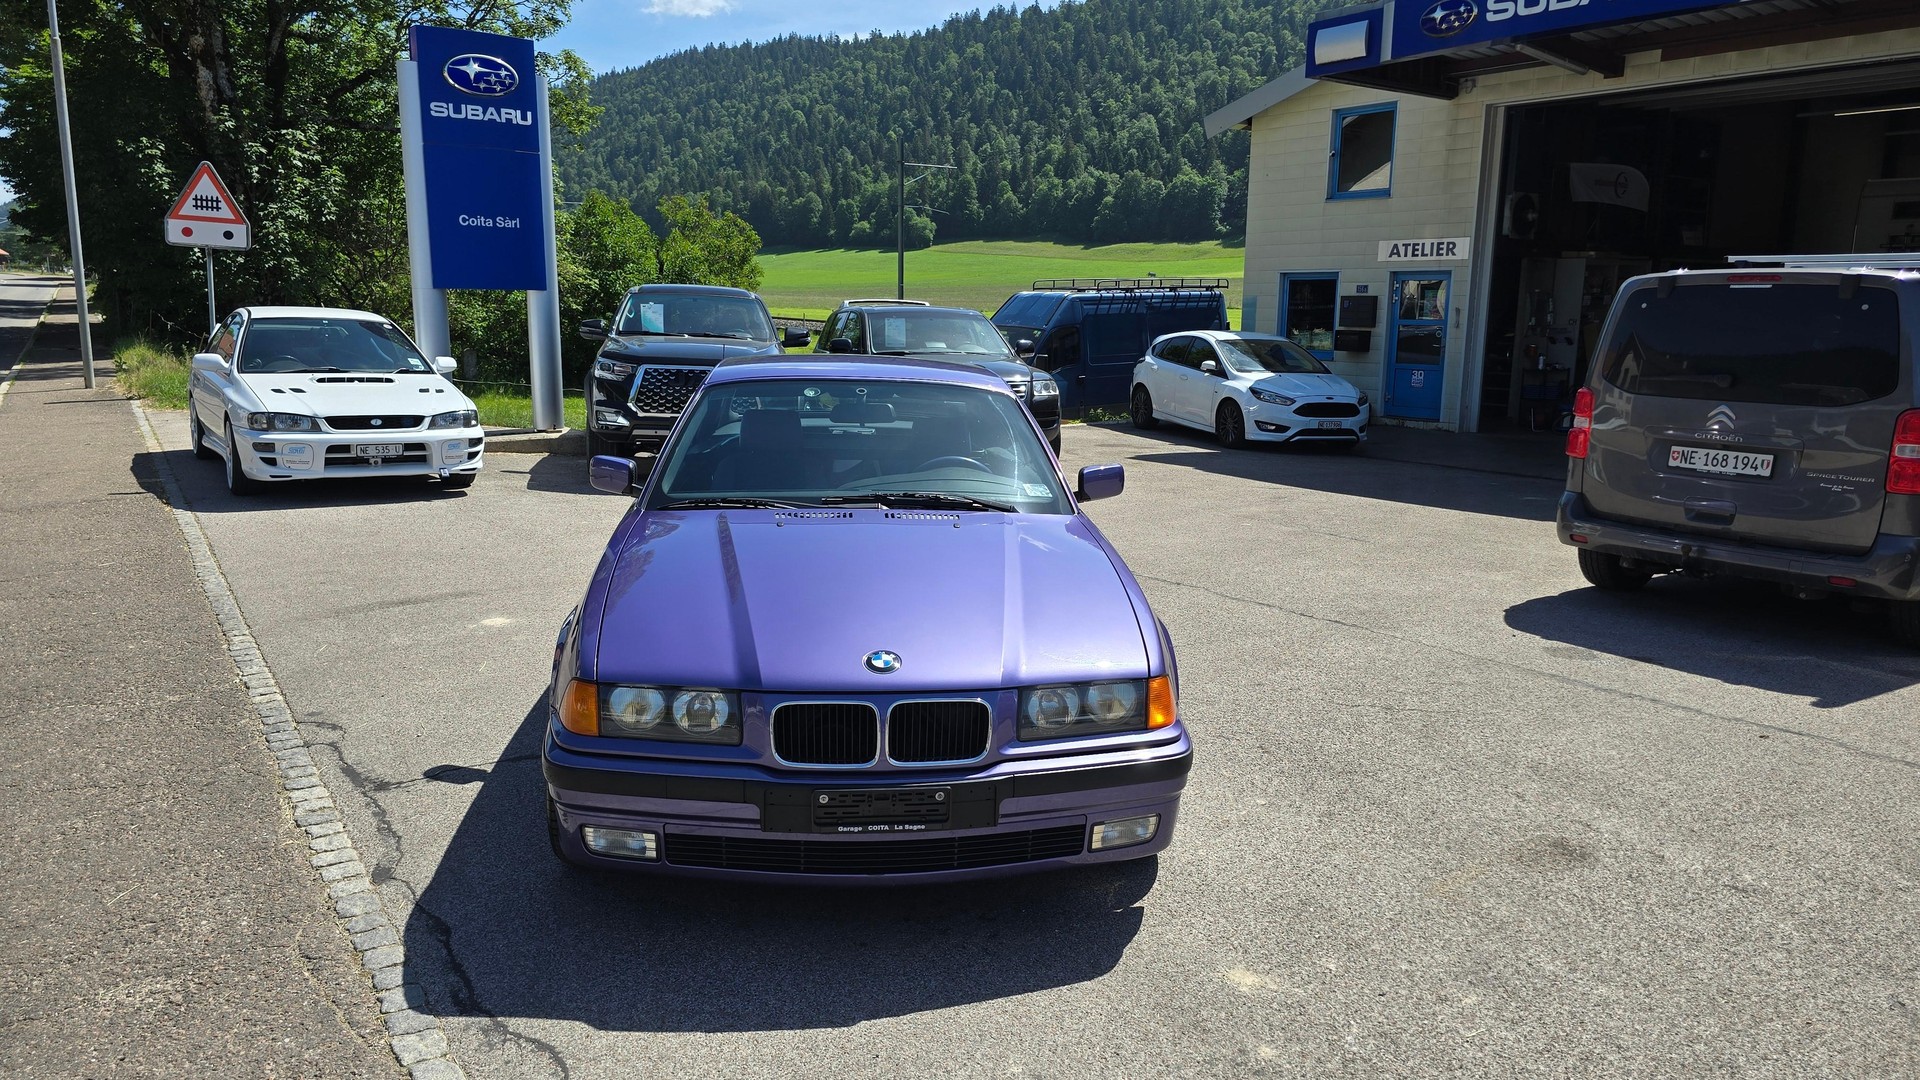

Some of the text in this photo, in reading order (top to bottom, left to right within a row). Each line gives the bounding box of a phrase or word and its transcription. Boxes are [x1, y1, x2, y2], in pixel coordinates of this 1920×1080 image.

[429, 101, 532, 125] SUBARU
[458, 214, 493, 227] Coita
[1388, 241, 1457, 258] ATELIER
[359, 445, 401, 454] NE 535 U
